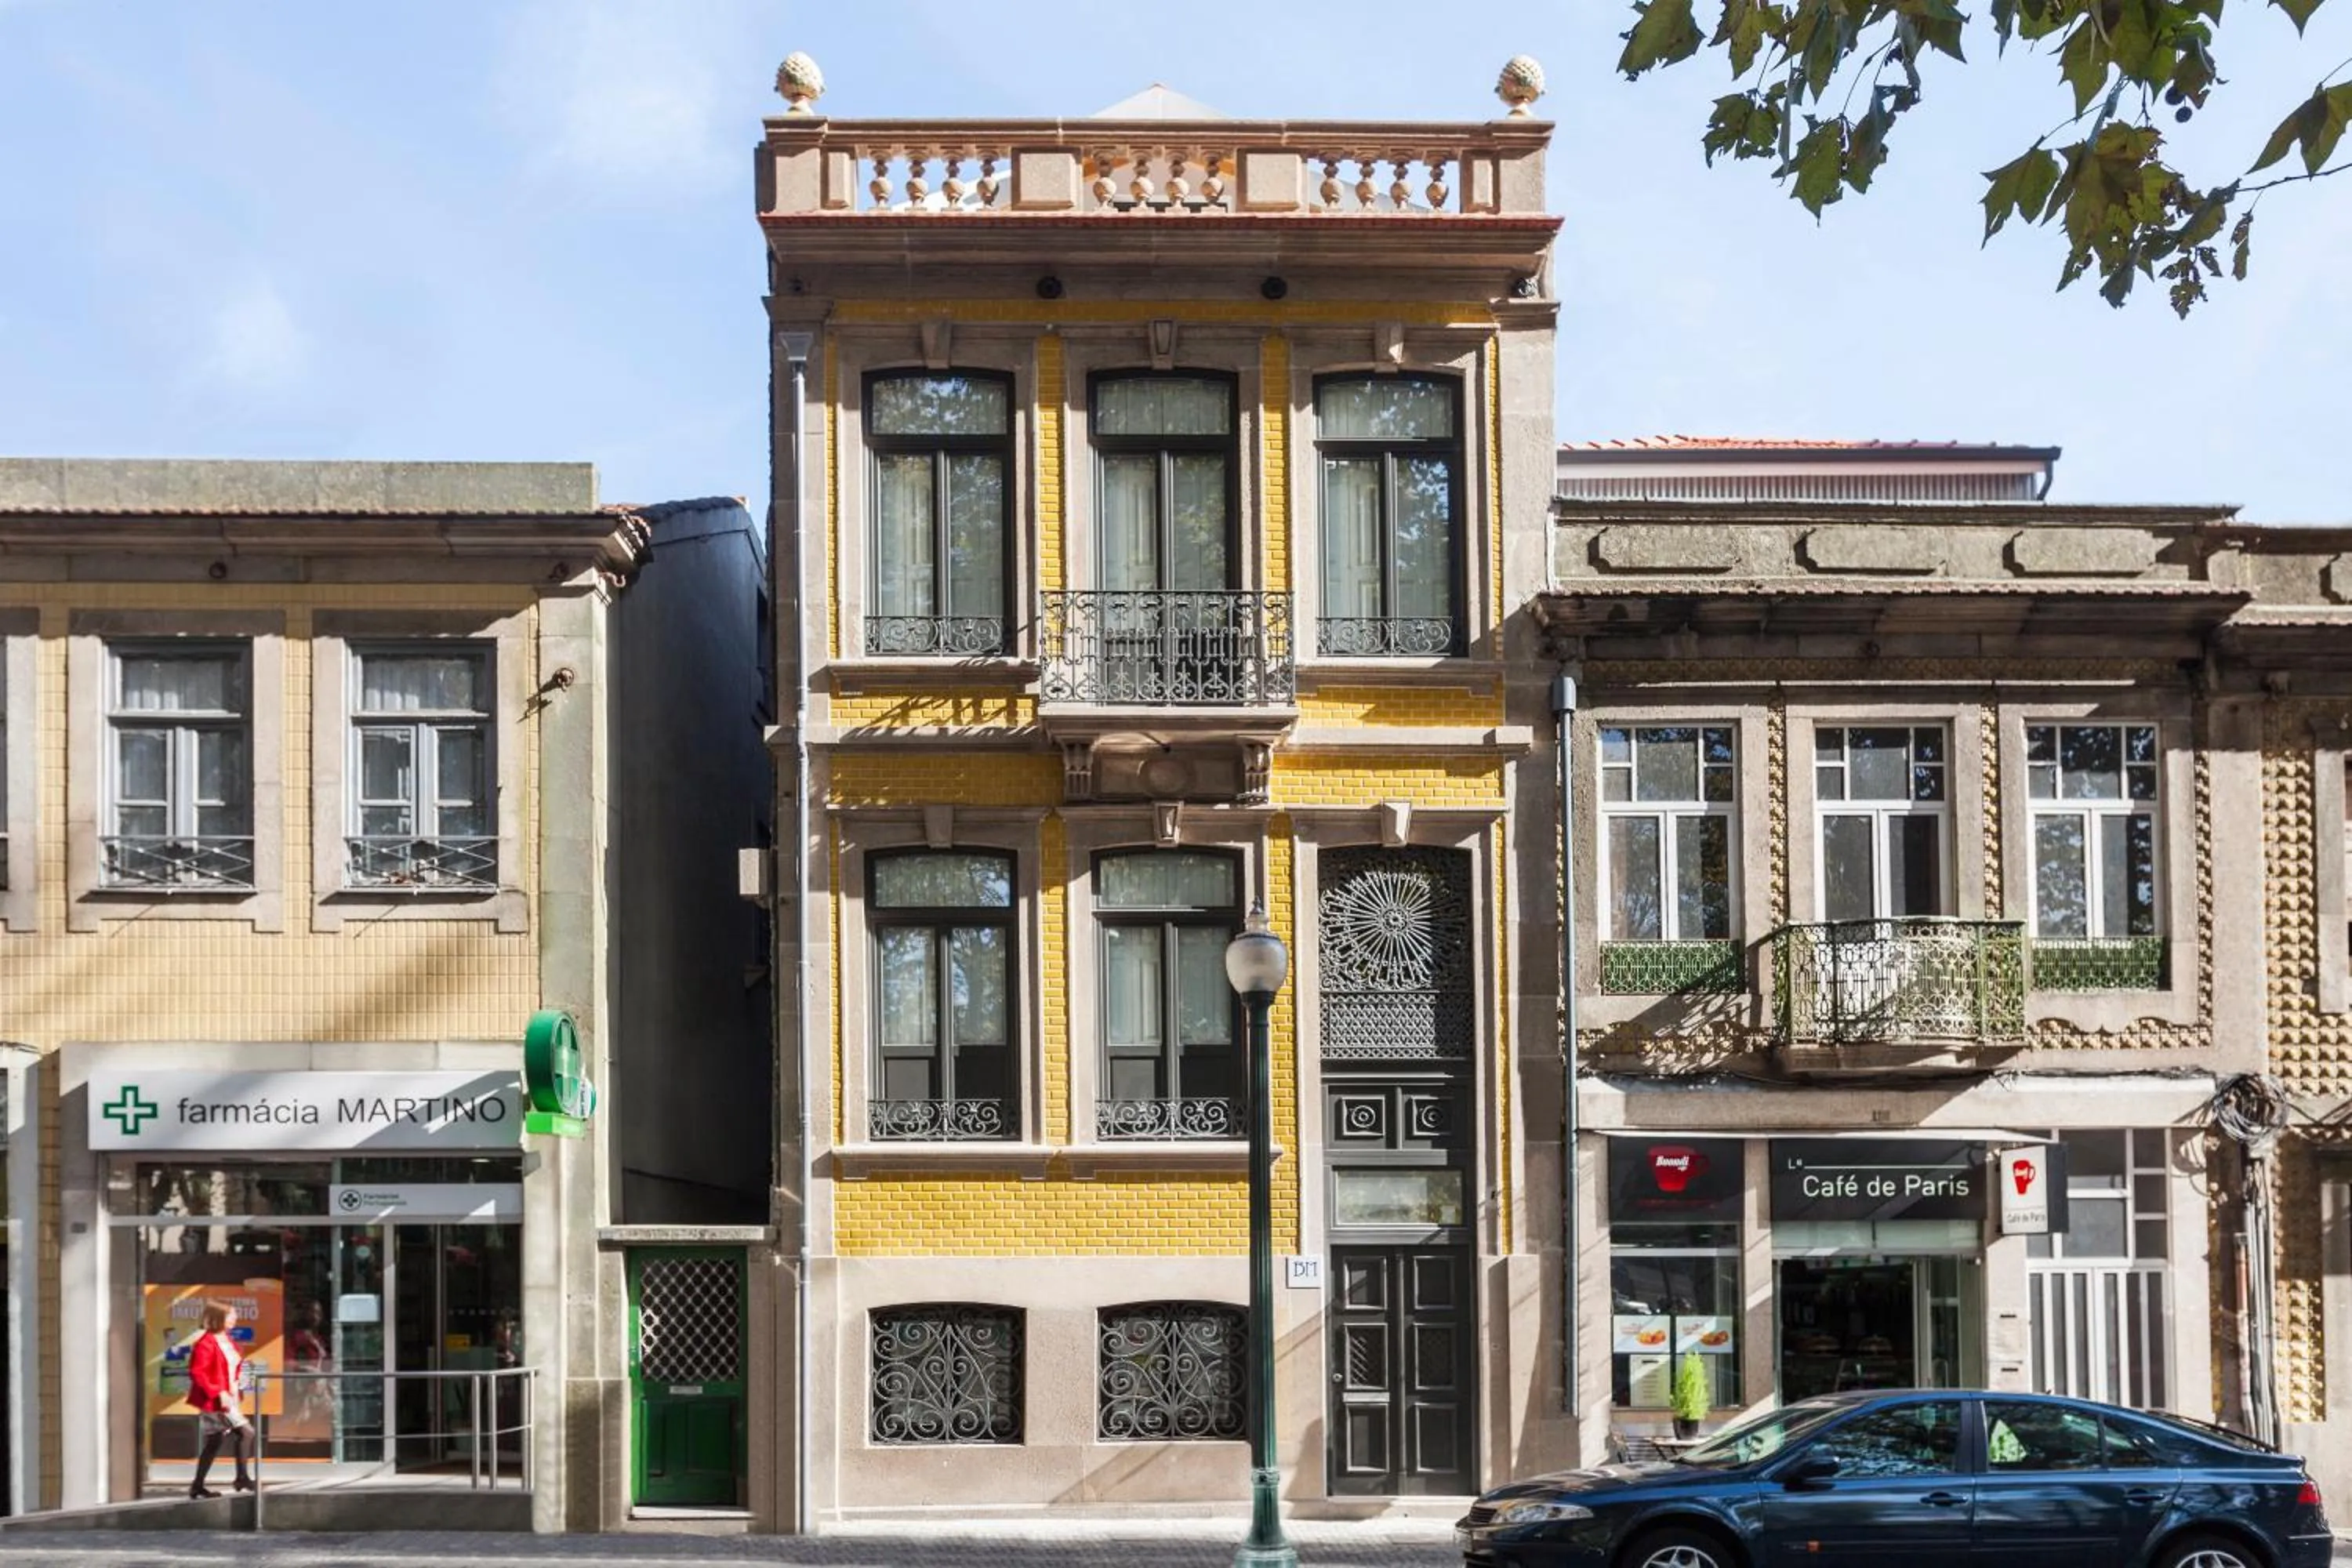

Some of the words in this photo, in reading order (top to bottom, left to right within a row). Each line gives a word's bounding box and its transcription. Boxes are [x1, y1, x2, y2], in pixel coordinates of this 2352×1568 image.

[177, 1098, 319, 1124] farmácia
[338, 1097, 506, 1123] MARTINO
[1802, 1174, 1859, 1197] Café
[1867, 1175, 1896, 1197] de
[1904, 1174, 1970, 1197] Paris
